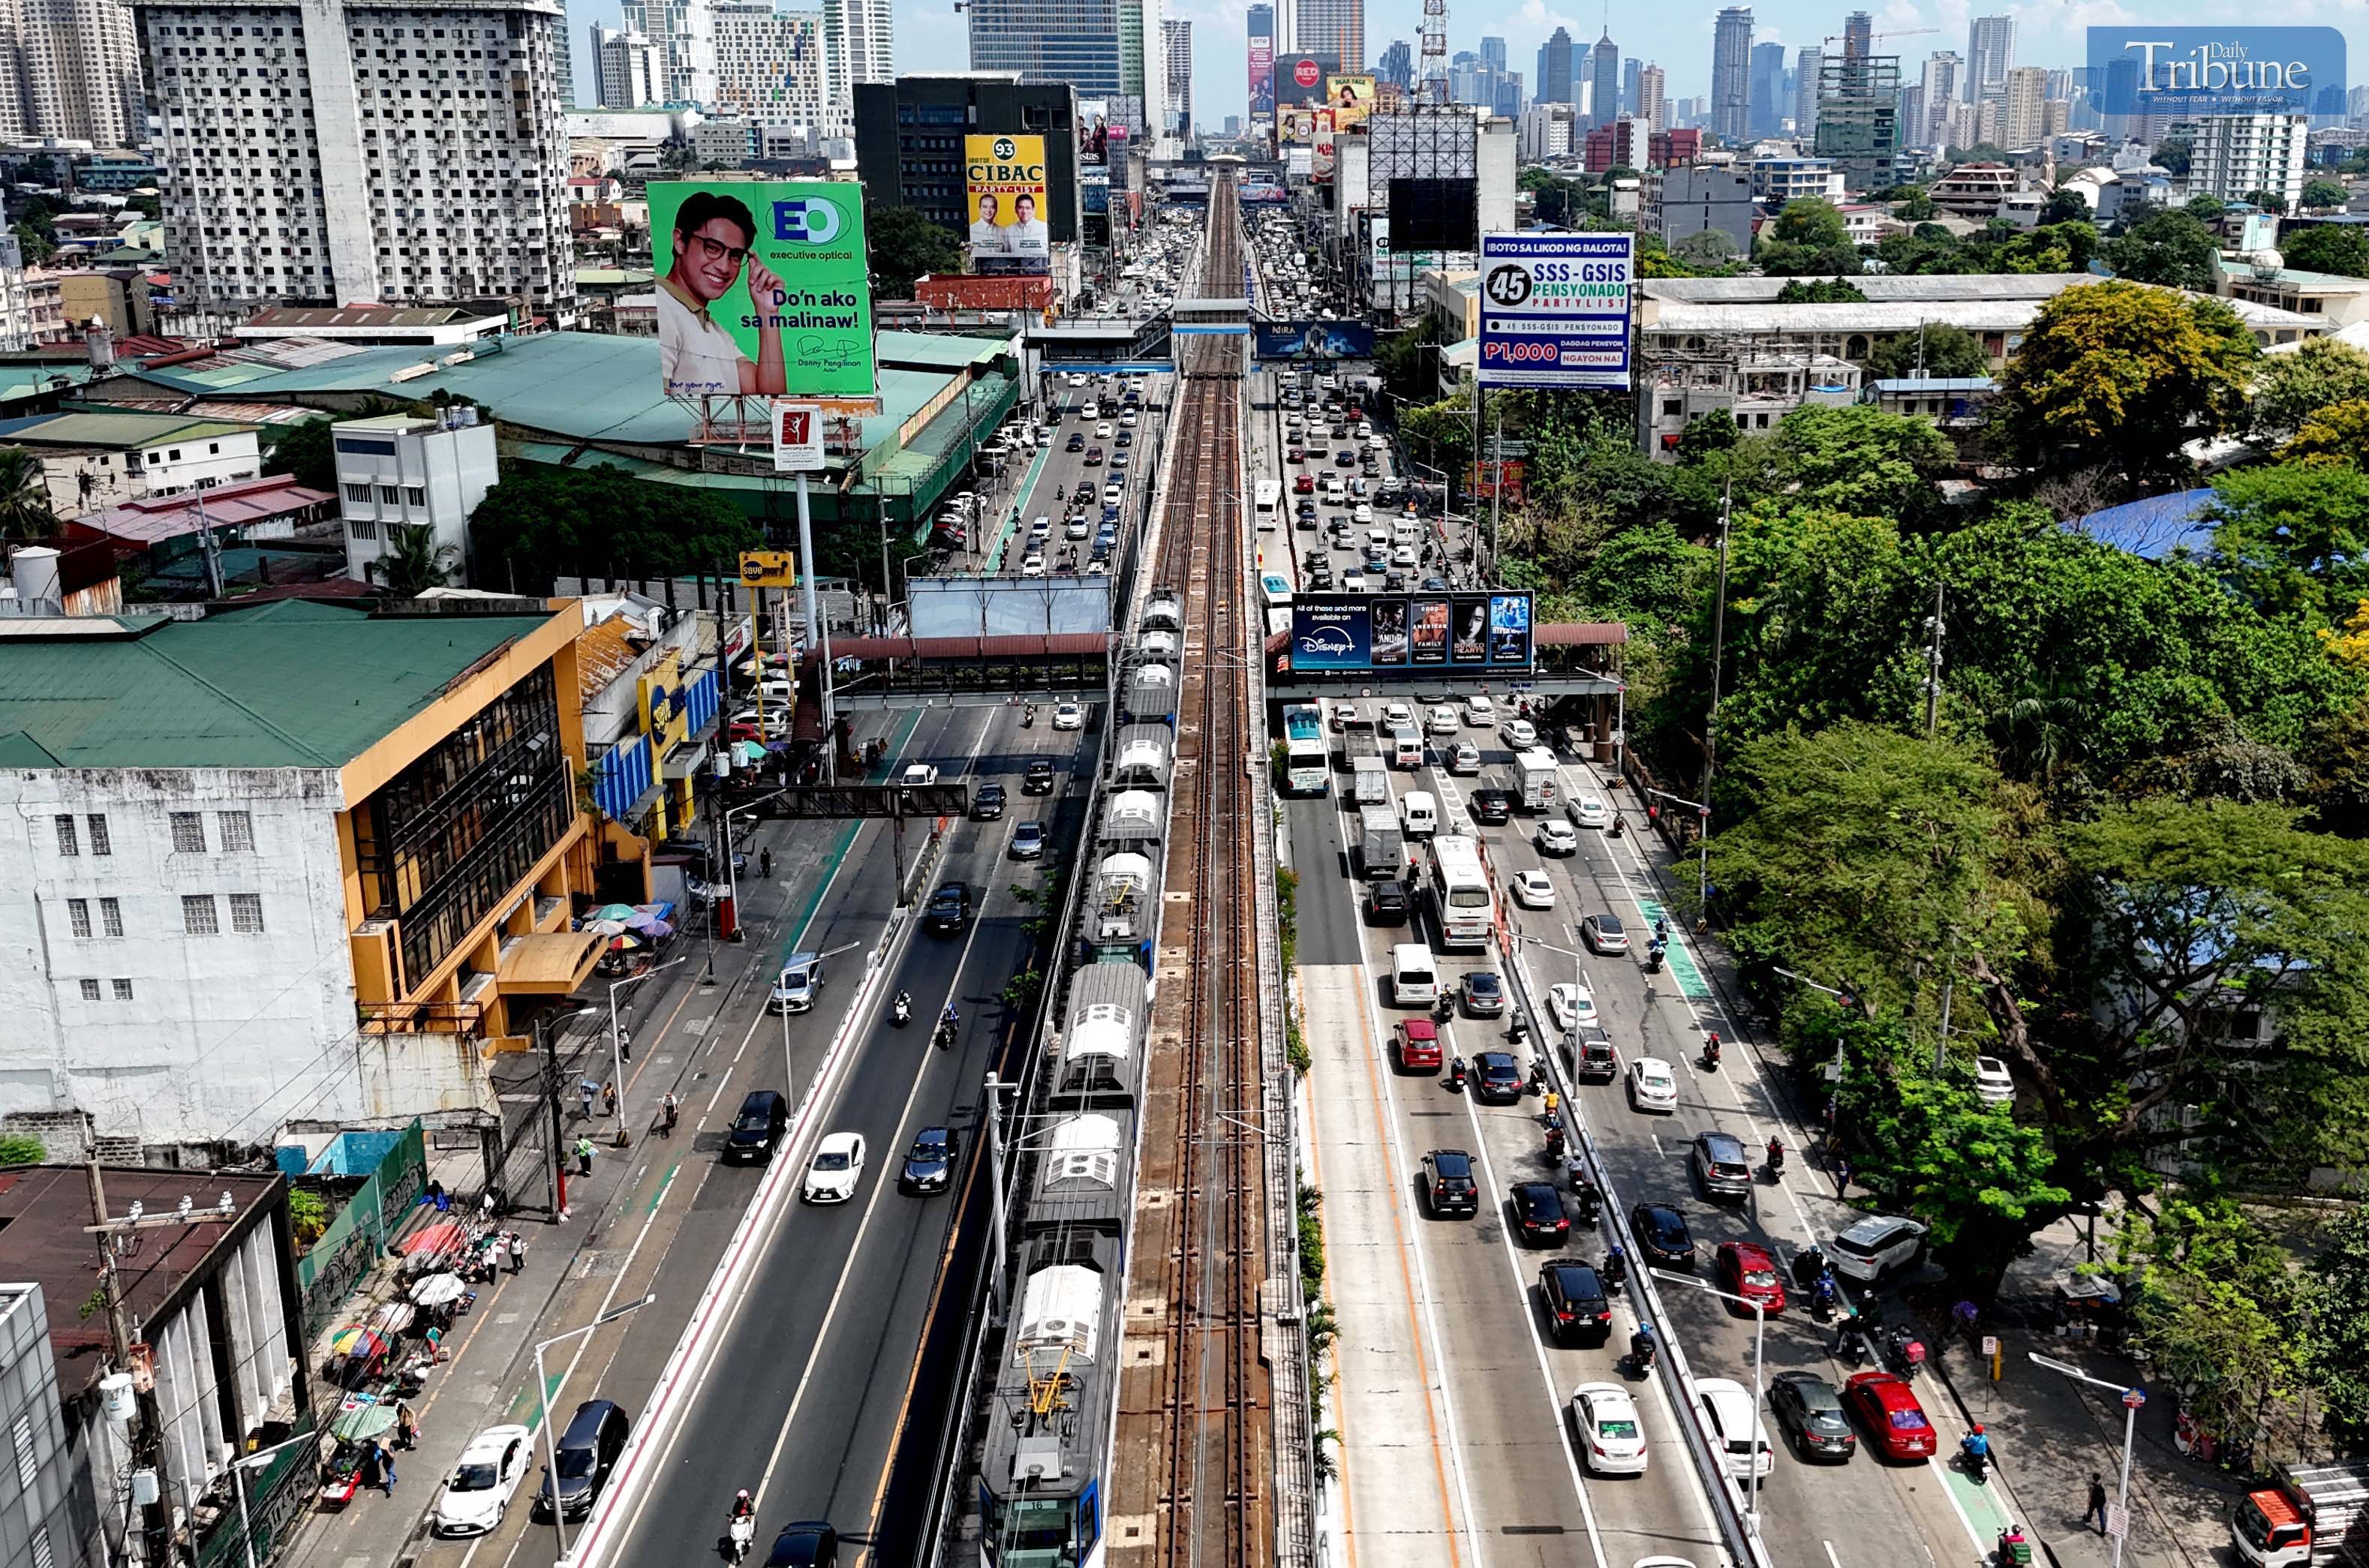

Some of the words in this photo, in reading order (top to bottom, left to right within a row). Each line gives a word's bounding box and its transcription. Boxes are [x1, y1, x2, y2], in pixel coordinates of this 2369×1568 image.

[995, 143, 1015, 156] 93
[967, 165, 1043, 182] CIBAC
[772, 197, 840, 244] EO
[1487, 242, 1517, 253] IBOTO
[1519, 242, 1532, 253] SA
[1533, 242, 1565, 253] LIKOD
[1565, 243, 1582, 253] NG
[1583, 243, 1627, 253] BALOTA!
[770, 251, 816, 260] executive
[818, 251, 852, 263] optical
[1492, 271, 1526, 301] 45
[1532, 283, 1625, 297] PENSYONADO
[773, 290, 816, 306] Do'n
[820, 290, 857, 307] ako
[1532, 298, 1625, 308] PARTYLIST
[740, 315, 763, 328] sa
[769, 311, 858, 328] malinaw!
[798, 359, 822, 367] Donny
[823, 359, 861, 368] Pangilinan
[1563, 354, 1603, 362] NGAYON
[743, 565, 763, 575] save
